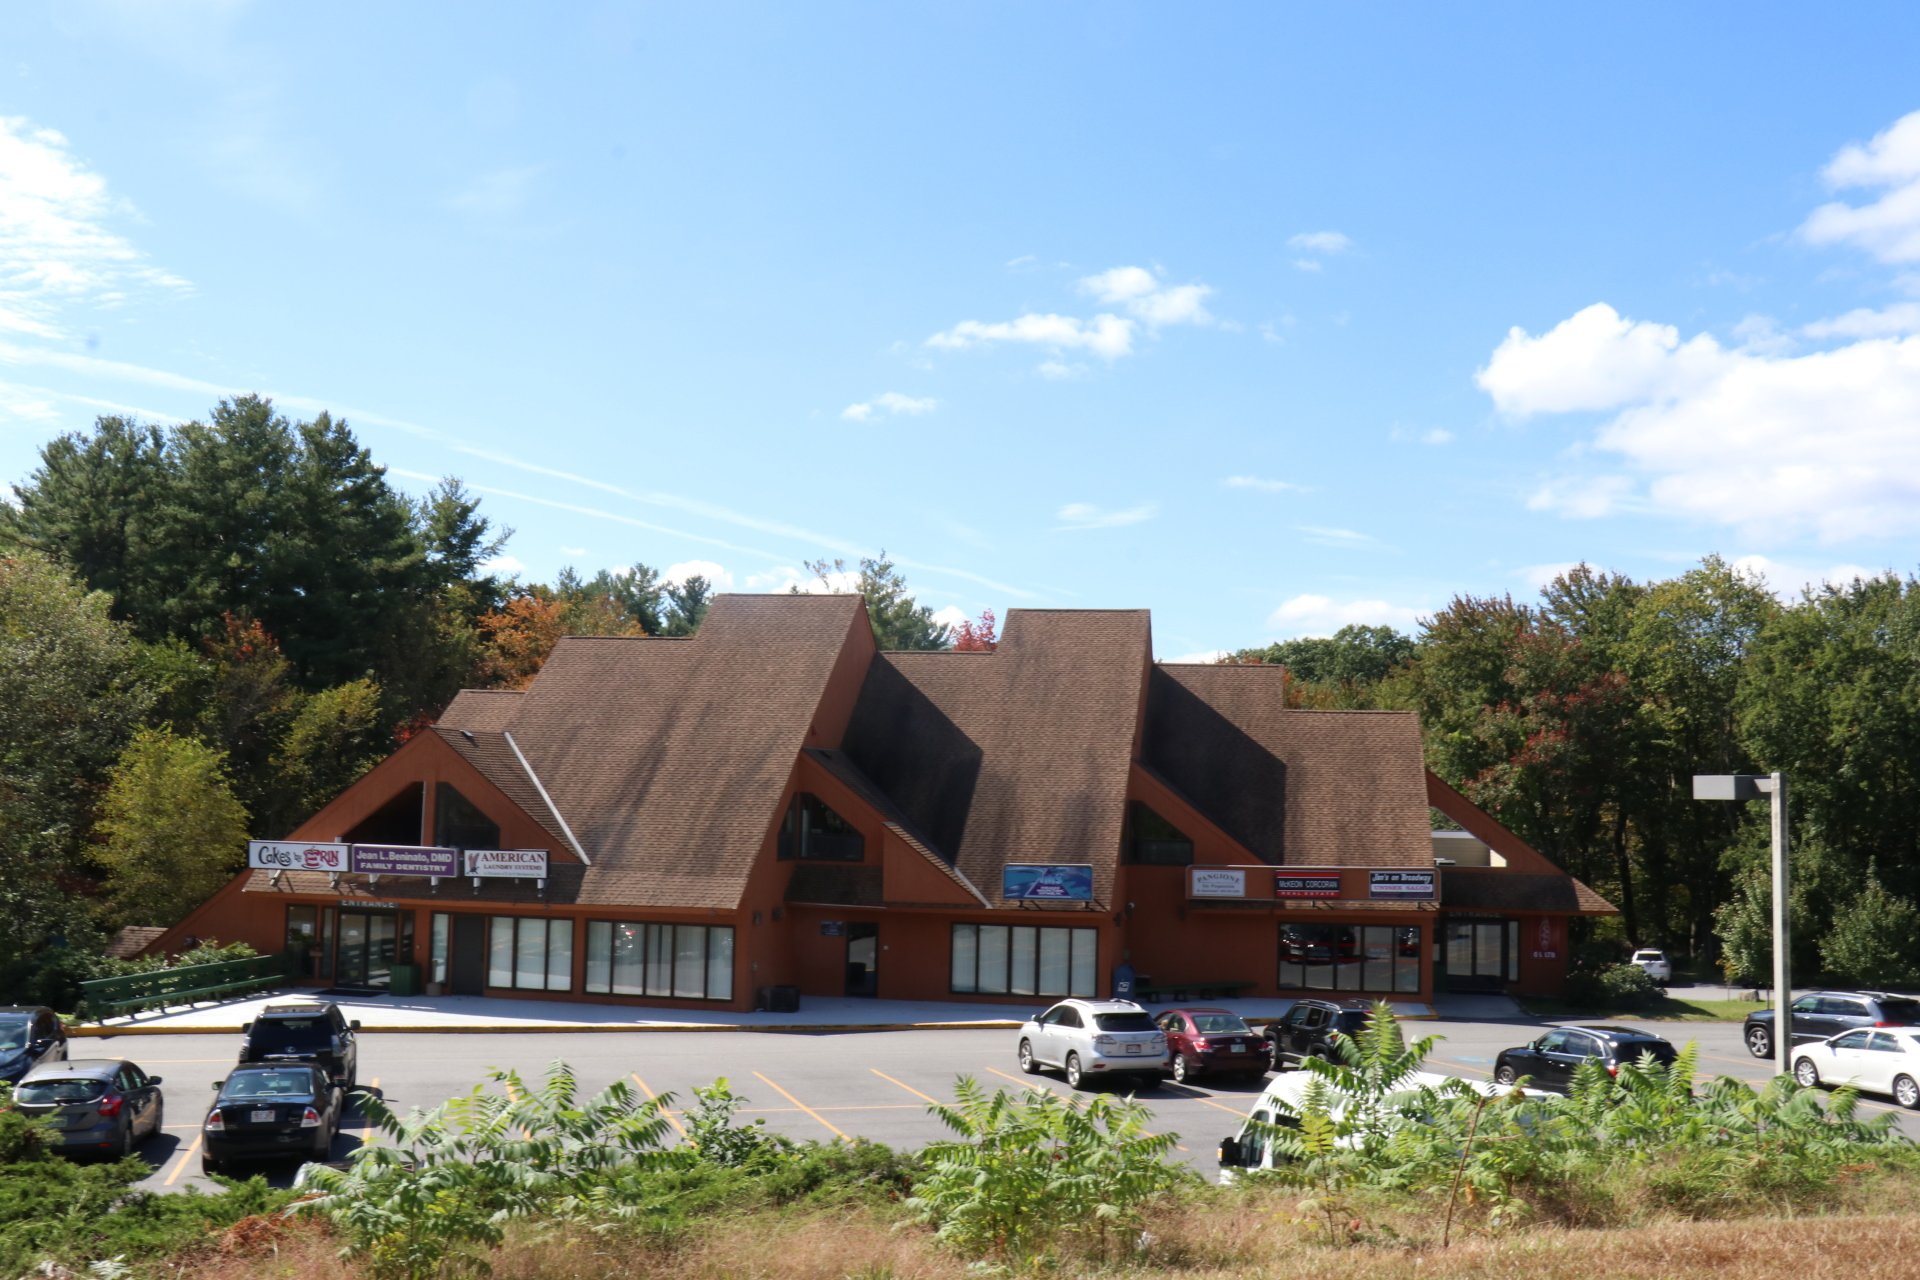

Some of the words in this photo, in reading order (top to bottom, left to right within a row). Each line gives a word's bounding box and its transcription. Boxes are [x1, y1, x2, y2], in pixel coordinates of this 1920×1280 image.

[258, 846, 292, 866] Cakes
[302, 846, 340, 868] ERIN
[356, 850, 378, 860] Jean
[430, 853, 453, 863] DMD
[481, 852, 545, 863] AMERICAN
[360, 862, 393, 870] FAMILY
[395, 863, 447, 872] DENTISTRY
[1305, 880, 1338, 888] CORCORAN
[1400, 873, 1433, 884] Broadway
[341, 900, 396, 908] ENTRANCE
